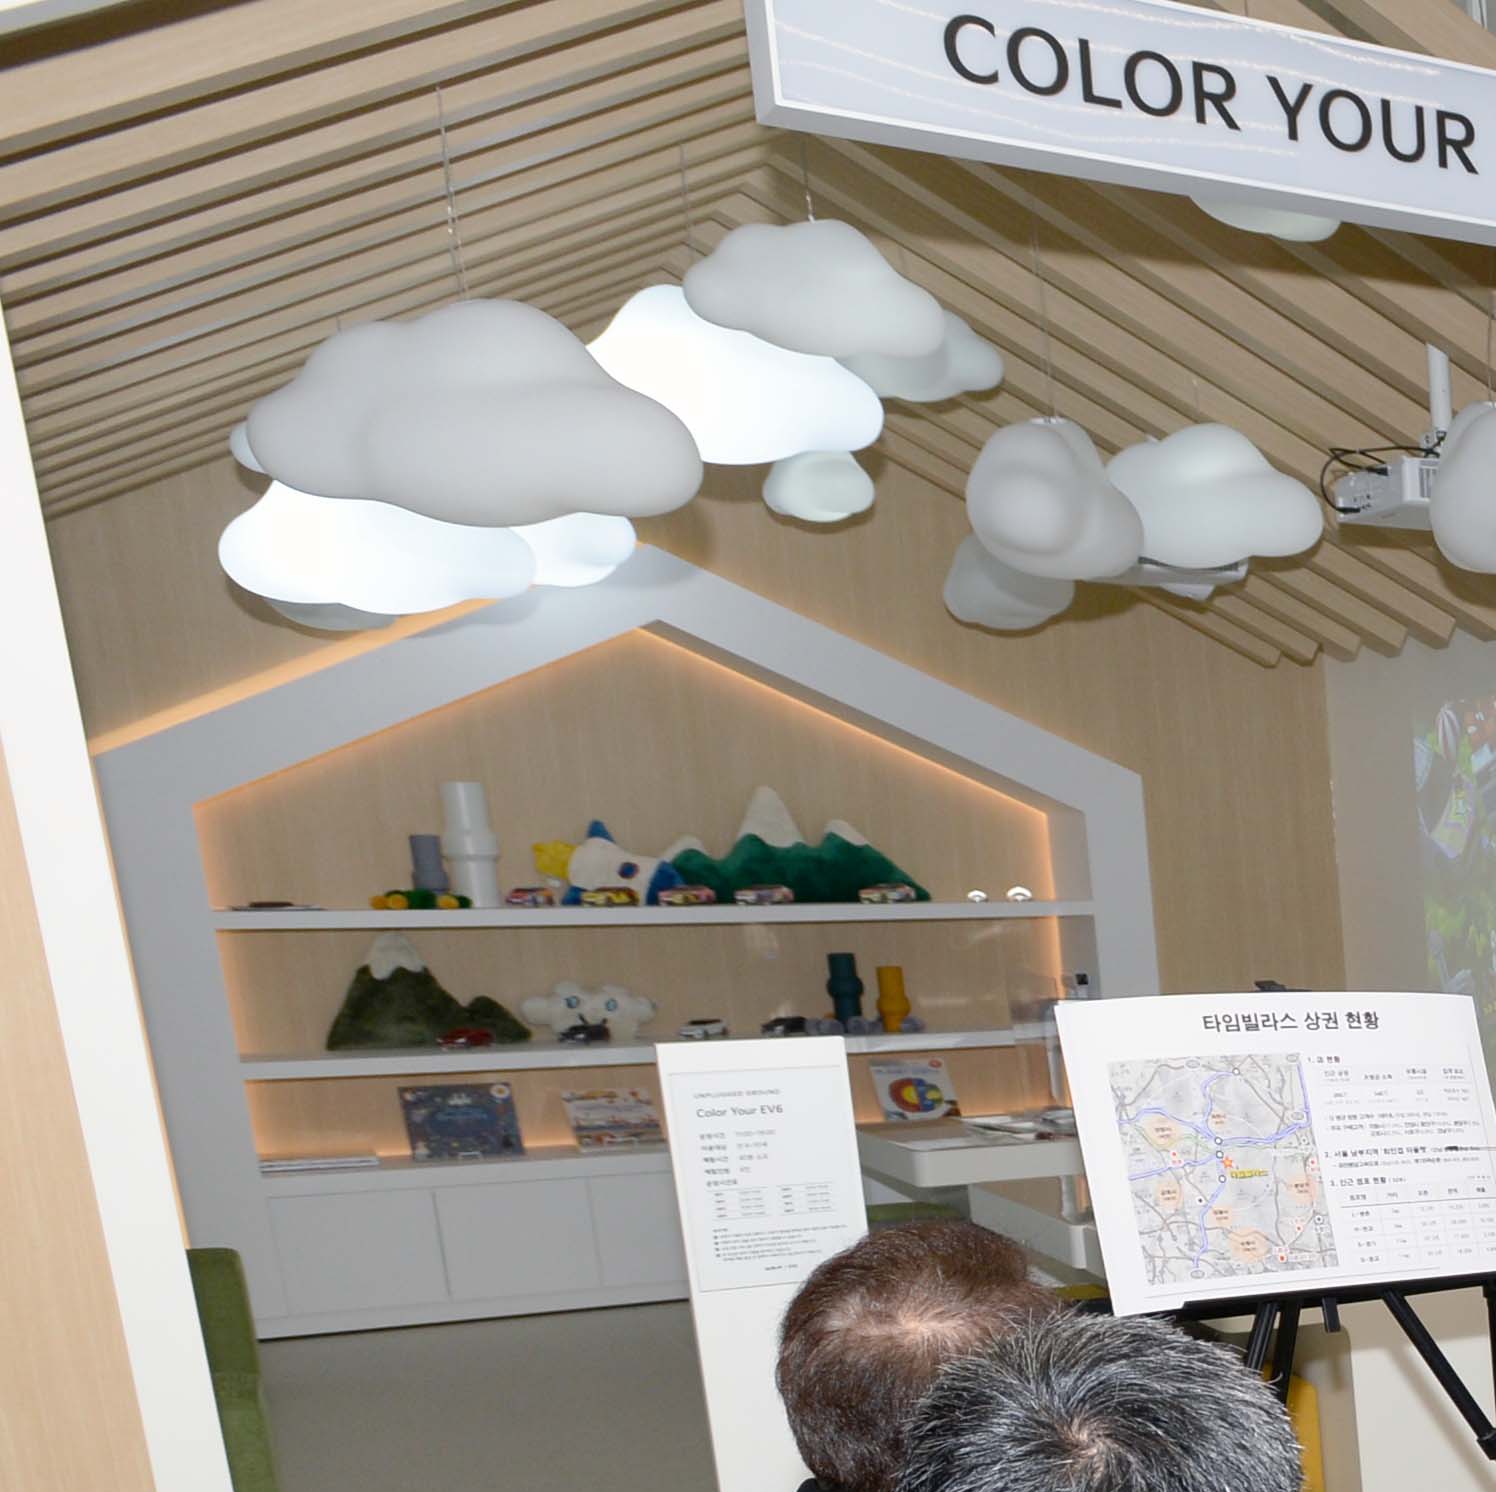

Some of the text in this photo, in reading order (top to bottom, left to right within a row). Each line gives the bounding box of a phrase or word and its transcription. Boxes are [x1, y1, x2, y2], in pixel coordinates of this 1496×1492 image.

[941, 13, 1241, 132] COLOR
[1265, 74, 1480, 175] YOUR
[1202, 1010, 1380, 1033] 타임빌라스 상권 현황
[696, 1103, 784, 1118] Color Your EV6
